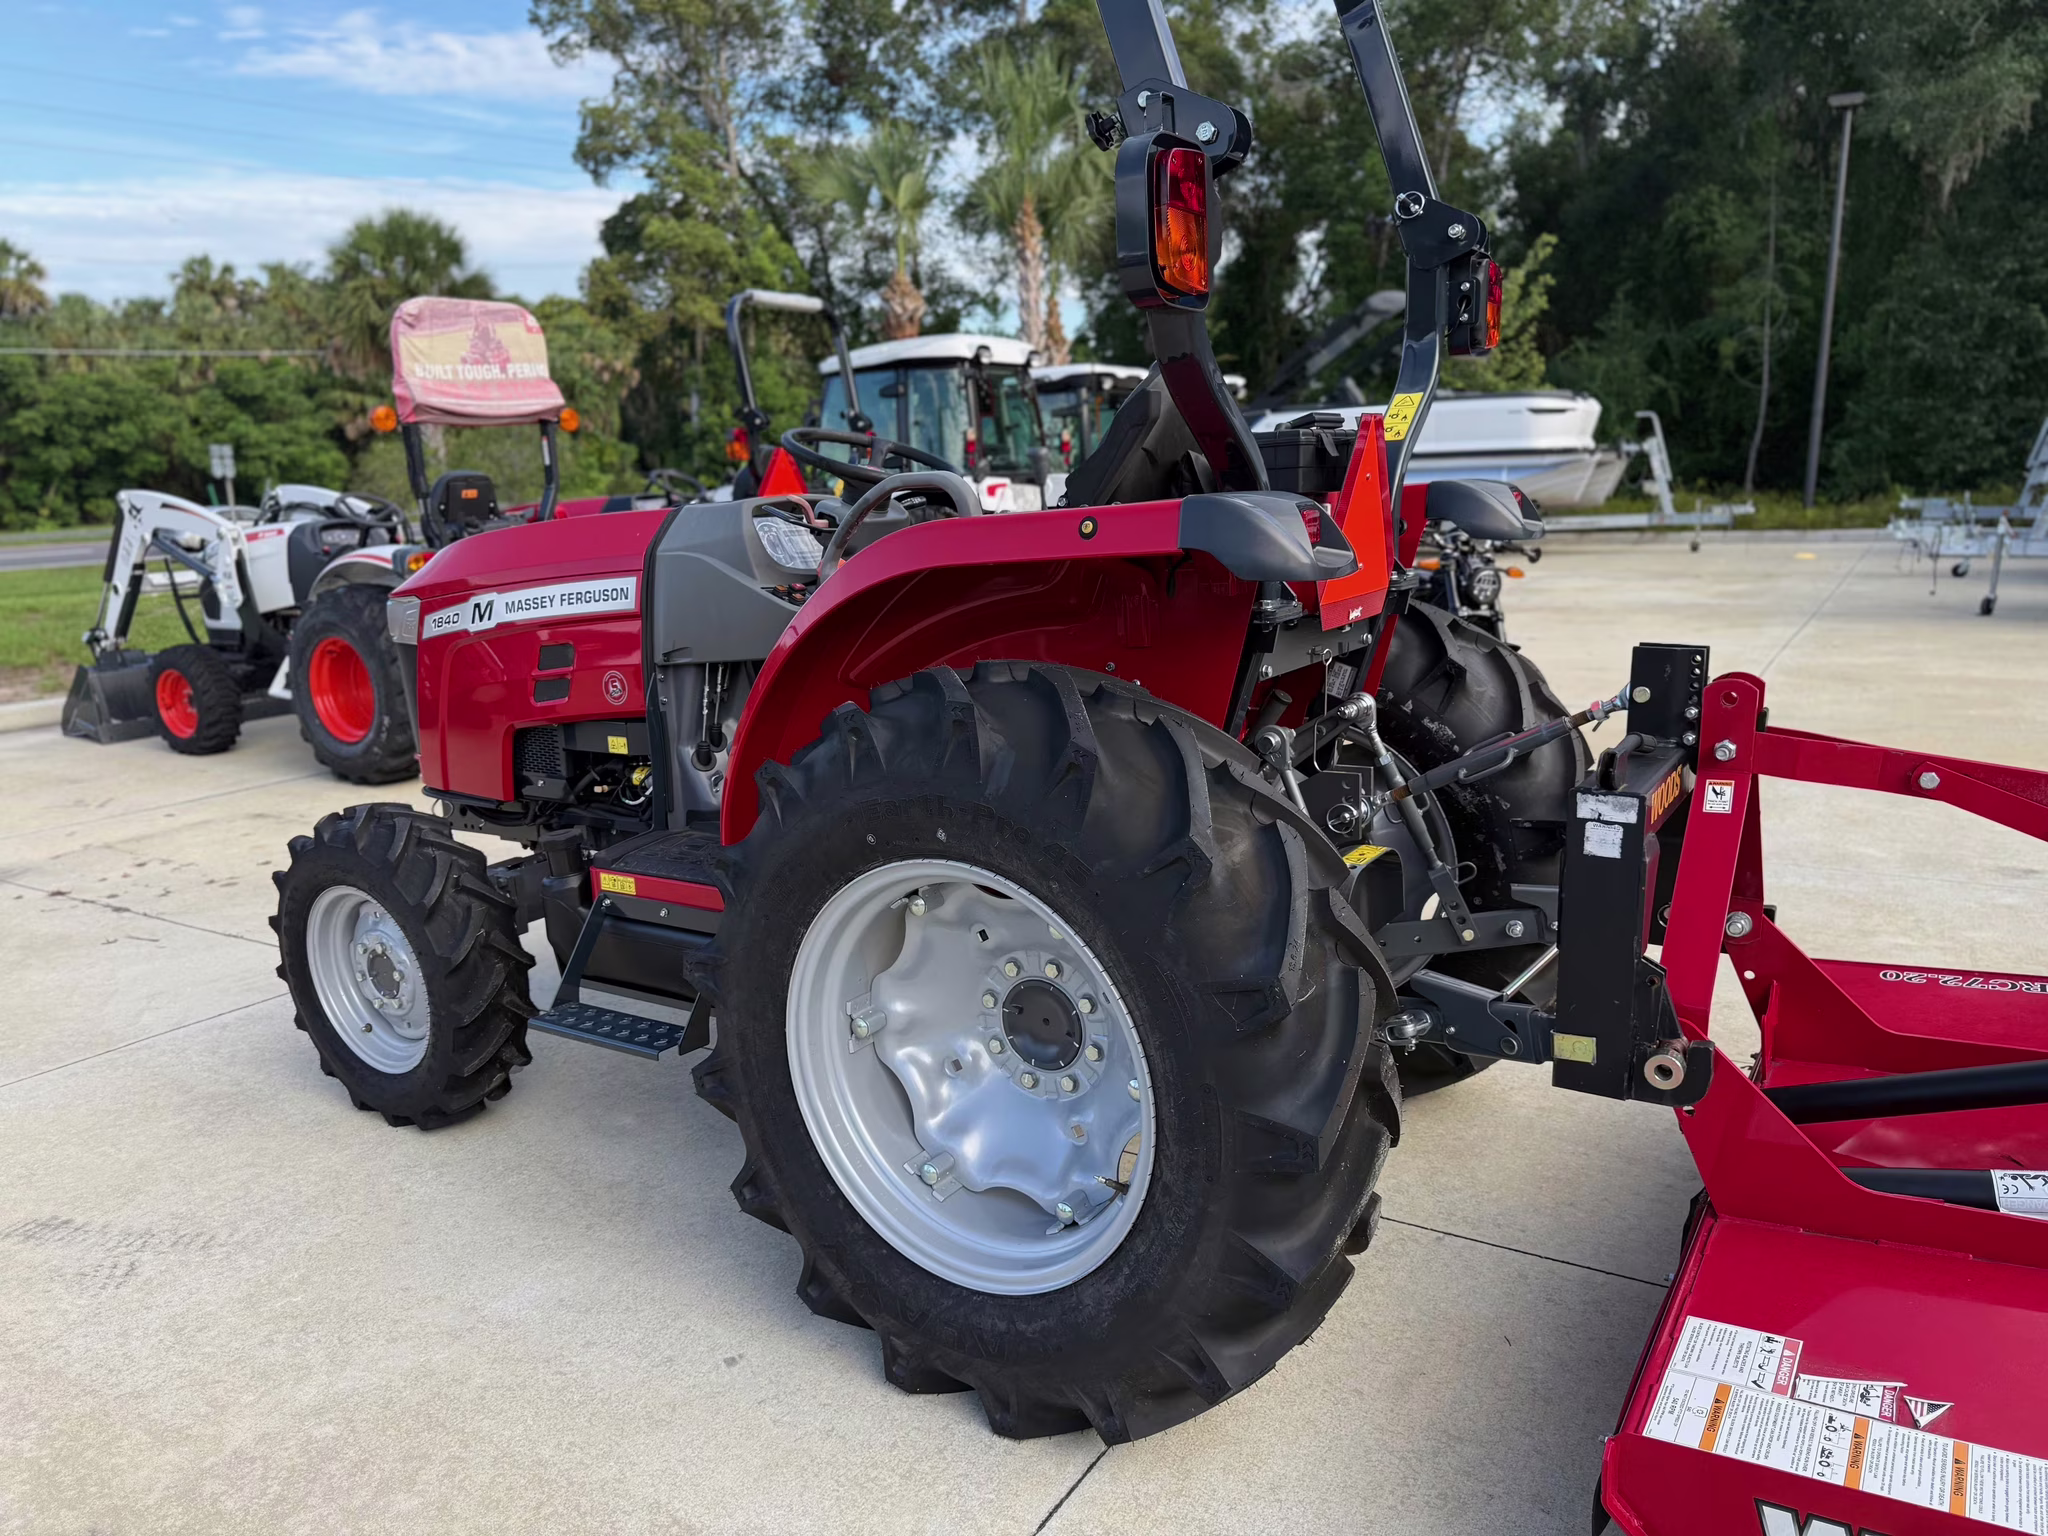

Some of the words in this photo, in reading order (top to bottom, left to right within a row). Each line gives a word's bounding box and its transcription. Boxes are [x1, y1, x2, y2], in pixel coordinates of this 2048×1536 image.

[415, 364, 453, 380] BUILT
[457, 364, 505, 380] TOUGH.
[431, 612, 460, 630] 1840
[471, 599, 494, 625] M
[505, 595, 556, 614] MASSEY
[560, 587, 629, 607] FERGUSON
[1651, 764, 1682, 824] WOODS
[1879, 969, 2048, 993] RC72.20
[1776, 1357, 1792, 1386] DANGER
[1880, 1389, 1895, 1417] DANGER
[1706, 1404, 1722, 1432] WARNING
[1849, 1440, 1862, 1469] WARNING
[1953, 1465, 1964, 1497] WARNING
